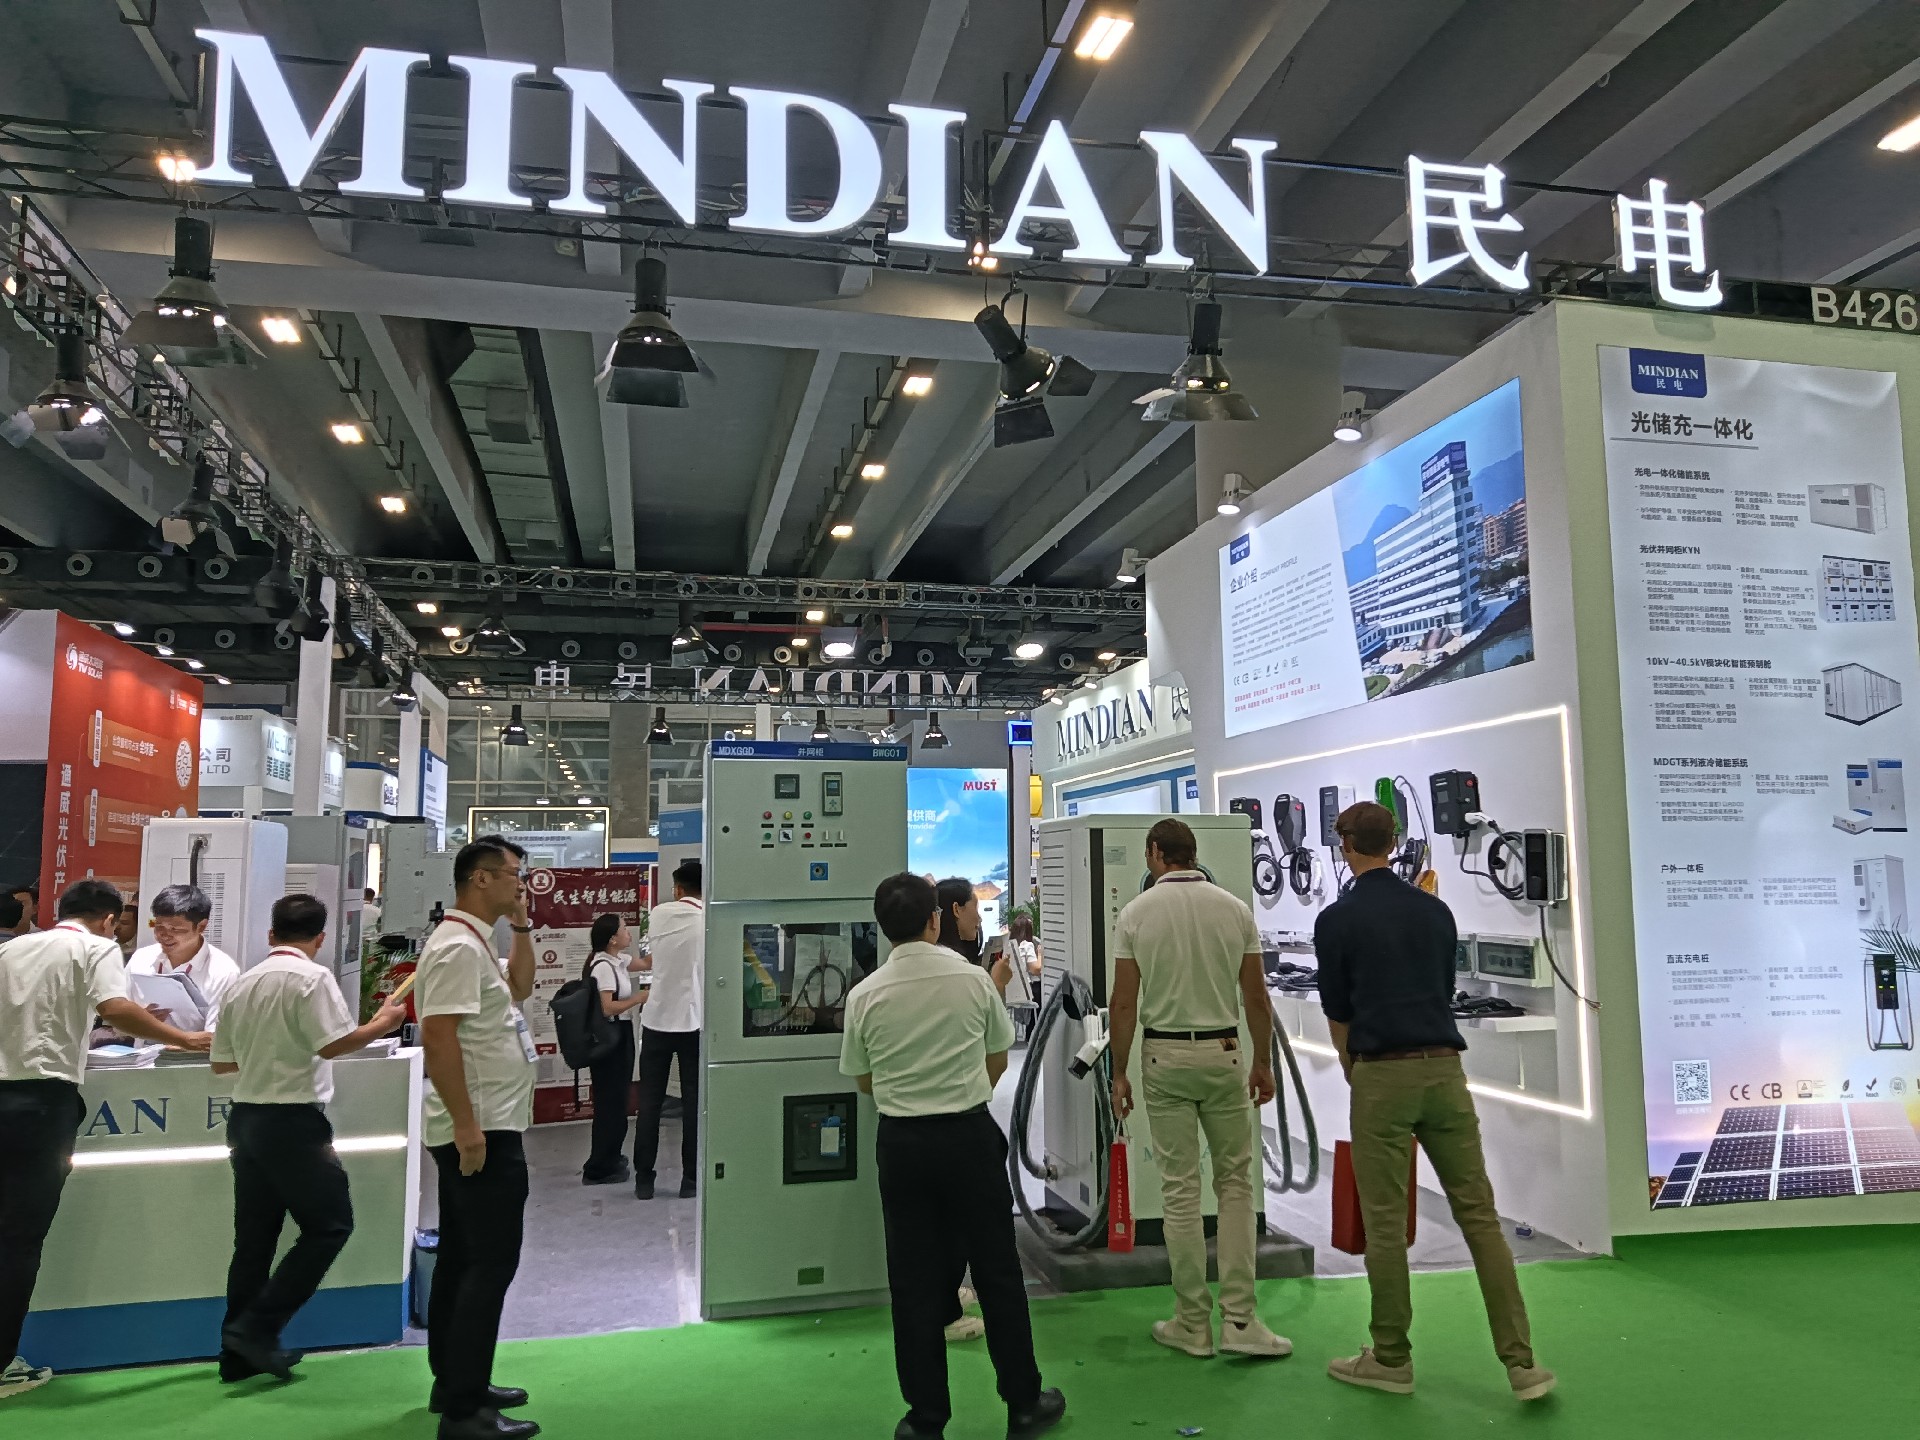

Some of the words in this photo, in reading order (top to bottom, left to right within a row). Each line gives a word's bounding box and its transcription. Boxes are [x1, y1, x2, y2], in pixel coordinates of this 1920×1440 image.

[194, 28, 1278, 275] MINDIAN
[1811, 287, 1918, 331] B426
[1637, 364, 1699, 380] MINDIAN
[1656, 378, 1684, 391] 民电
[1631, 411, 1754, 440] 光储充一体化
[1634, 467, 1710, 481] 光电一体化储能系统
[1639, 544, 1701, 555] 光伏并网柜KYN
[1056, 685, 1156, 757] MINDIAN
[718, 746, 755, 756] MDXGGD
[207, 765, 230, 774] LTD
[963, 779, 997, 791] MUST
[553, 886, 637, 905] 民生智慧能源
[1730, 1084, 1750, 1101] CE
[1761, 1082, 1782, 1099] CB
[82, 1097, 171, 1136] AN
